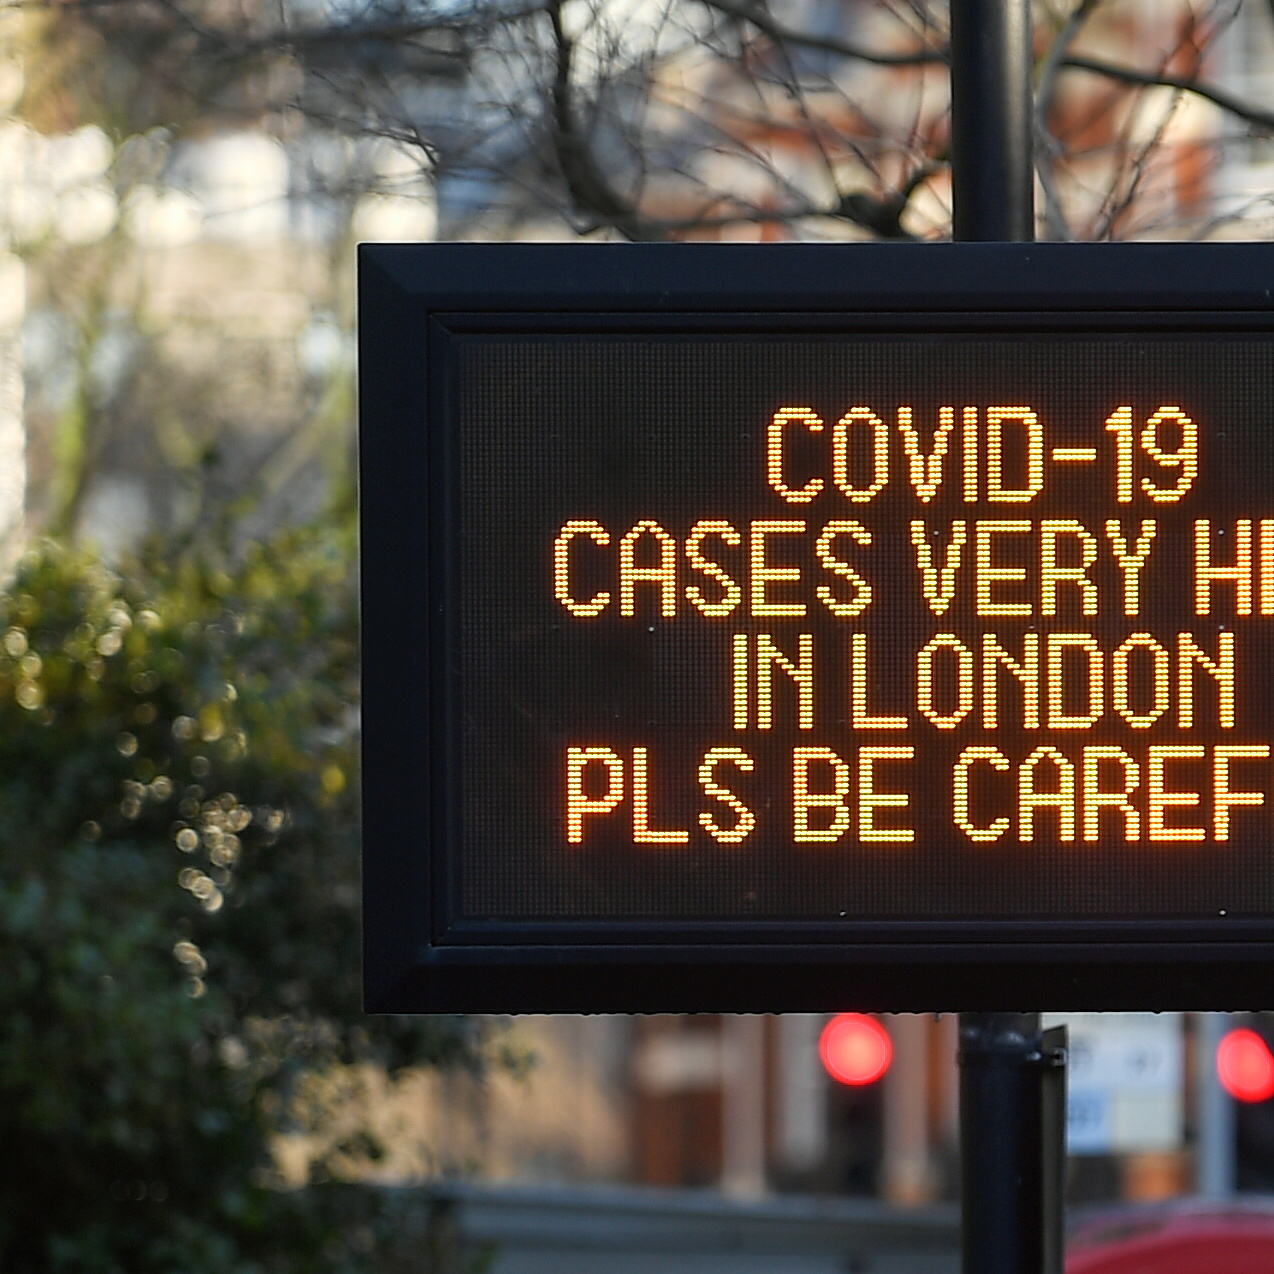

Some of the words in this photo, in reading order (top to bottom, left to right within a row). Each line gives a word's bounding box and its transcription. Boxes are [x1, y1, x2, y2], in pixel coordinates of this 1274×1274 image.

[767, 406, 1200, 503] COVID-19
[554, 518, 873, 617] CASES
[910, 518, 1157, 617] VERY
[732, 631, 815, 731] IN
[852, 631, 1235, 731] LONDON
[566, 744, 756, 843] PLS
[792, 744, 915, 843] BE
